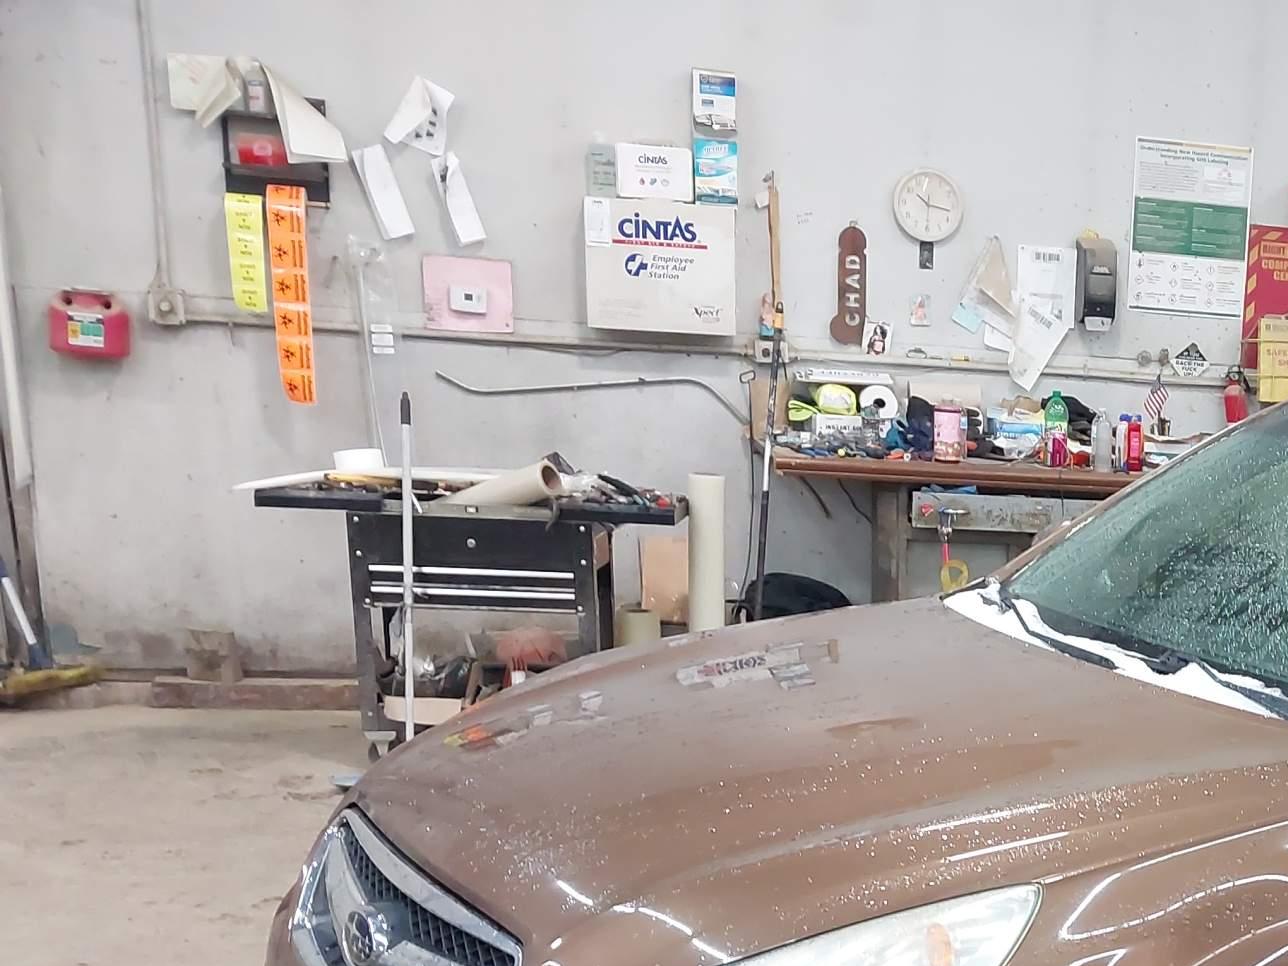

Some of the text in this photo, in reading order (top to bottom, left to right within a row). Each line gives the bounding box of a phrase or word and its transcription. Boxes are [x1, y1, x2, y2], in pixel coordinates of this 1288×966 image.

[638, 153, 668, 165] CINTAS
[617, 212, 697, 243] CINTAS
[652, 254, 695, 265] Employee
[650, 263, 687, 273] First Aid
[648, 271, 680, 280] Station
[845, 254, 861, 327] CHAD
